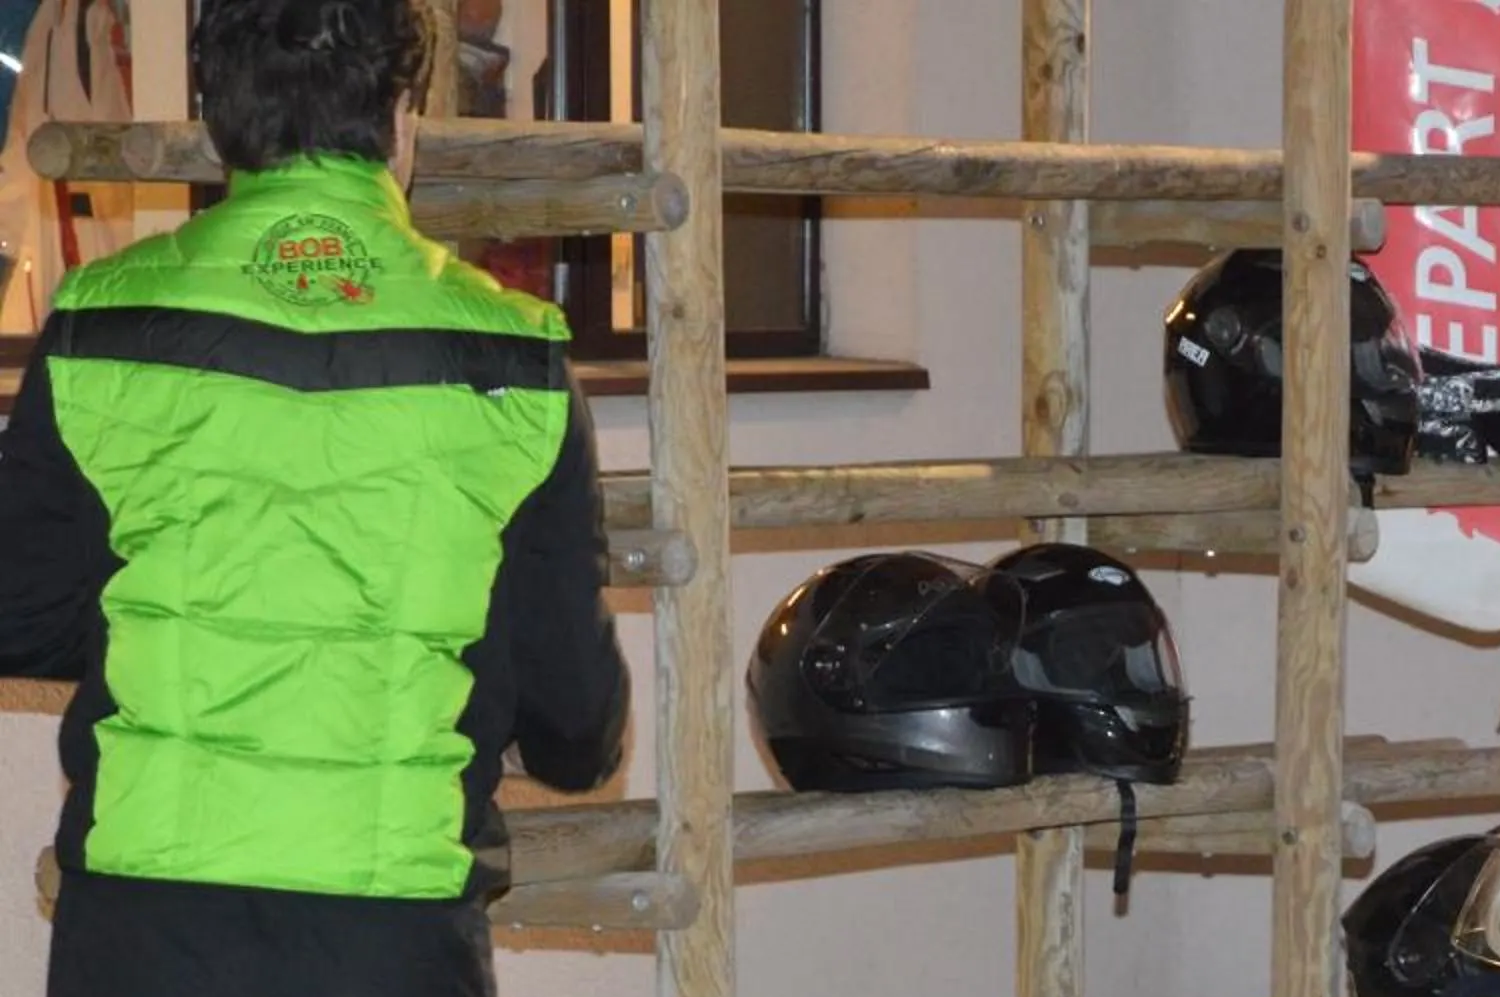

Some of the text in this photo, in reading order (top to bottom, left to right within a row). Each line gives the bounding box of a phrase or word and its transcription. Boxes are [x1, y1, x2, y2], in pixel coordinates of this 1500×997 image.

[1411, 38, 1497, 363] EPART
[278, 236, 342, 262] BOB
[240, 256, 383, 276] EXPERIENCE
